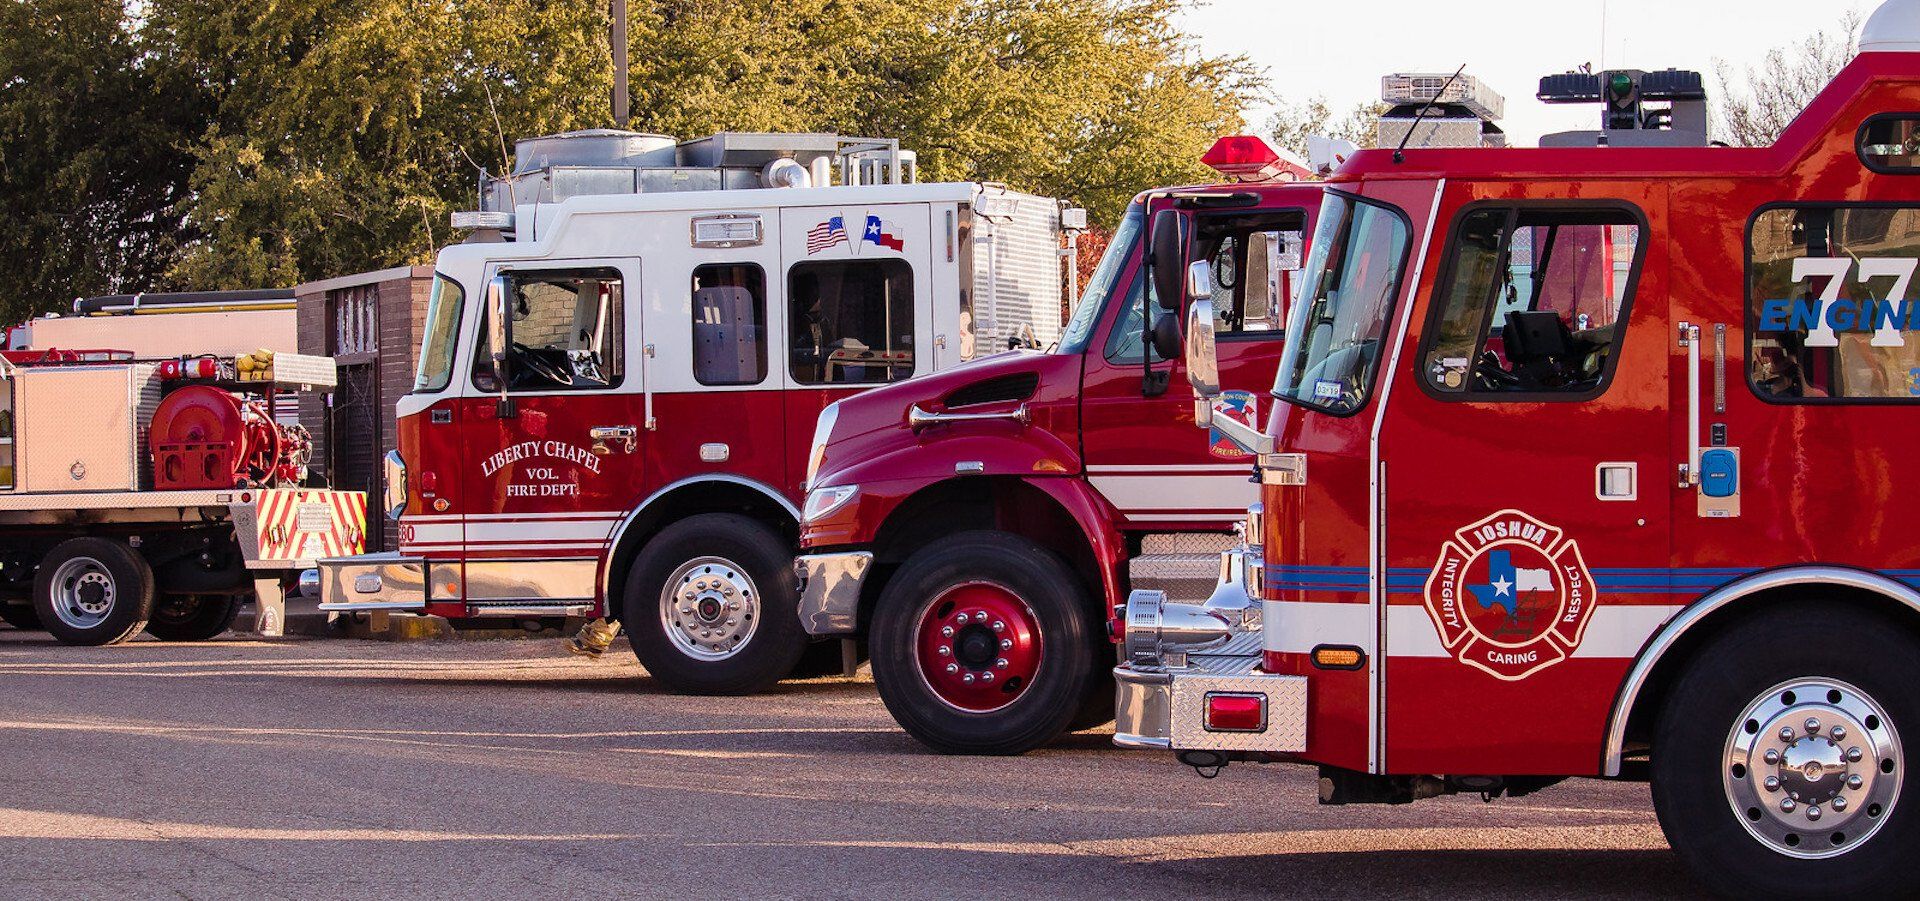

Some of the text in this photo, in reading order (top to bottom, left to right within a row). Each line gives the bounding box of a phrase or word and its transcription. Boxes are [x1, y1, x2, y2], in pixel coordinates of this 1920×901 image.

[1791, 257, 1919, 347] 77
[481, 440, 601, 478] LIBERTY CHAPEL
[525, 468, 559, 480] VOL.
[506, 483, 581, 496] FIRE DEPT.
[1473, 520, 1548, 546] JOSHUA
[1441, 557, 1462, 629] INTEGRITY
[1563, 565, 1582, 623] RESPECT
[1487, 650, 1538, 665] CARING
